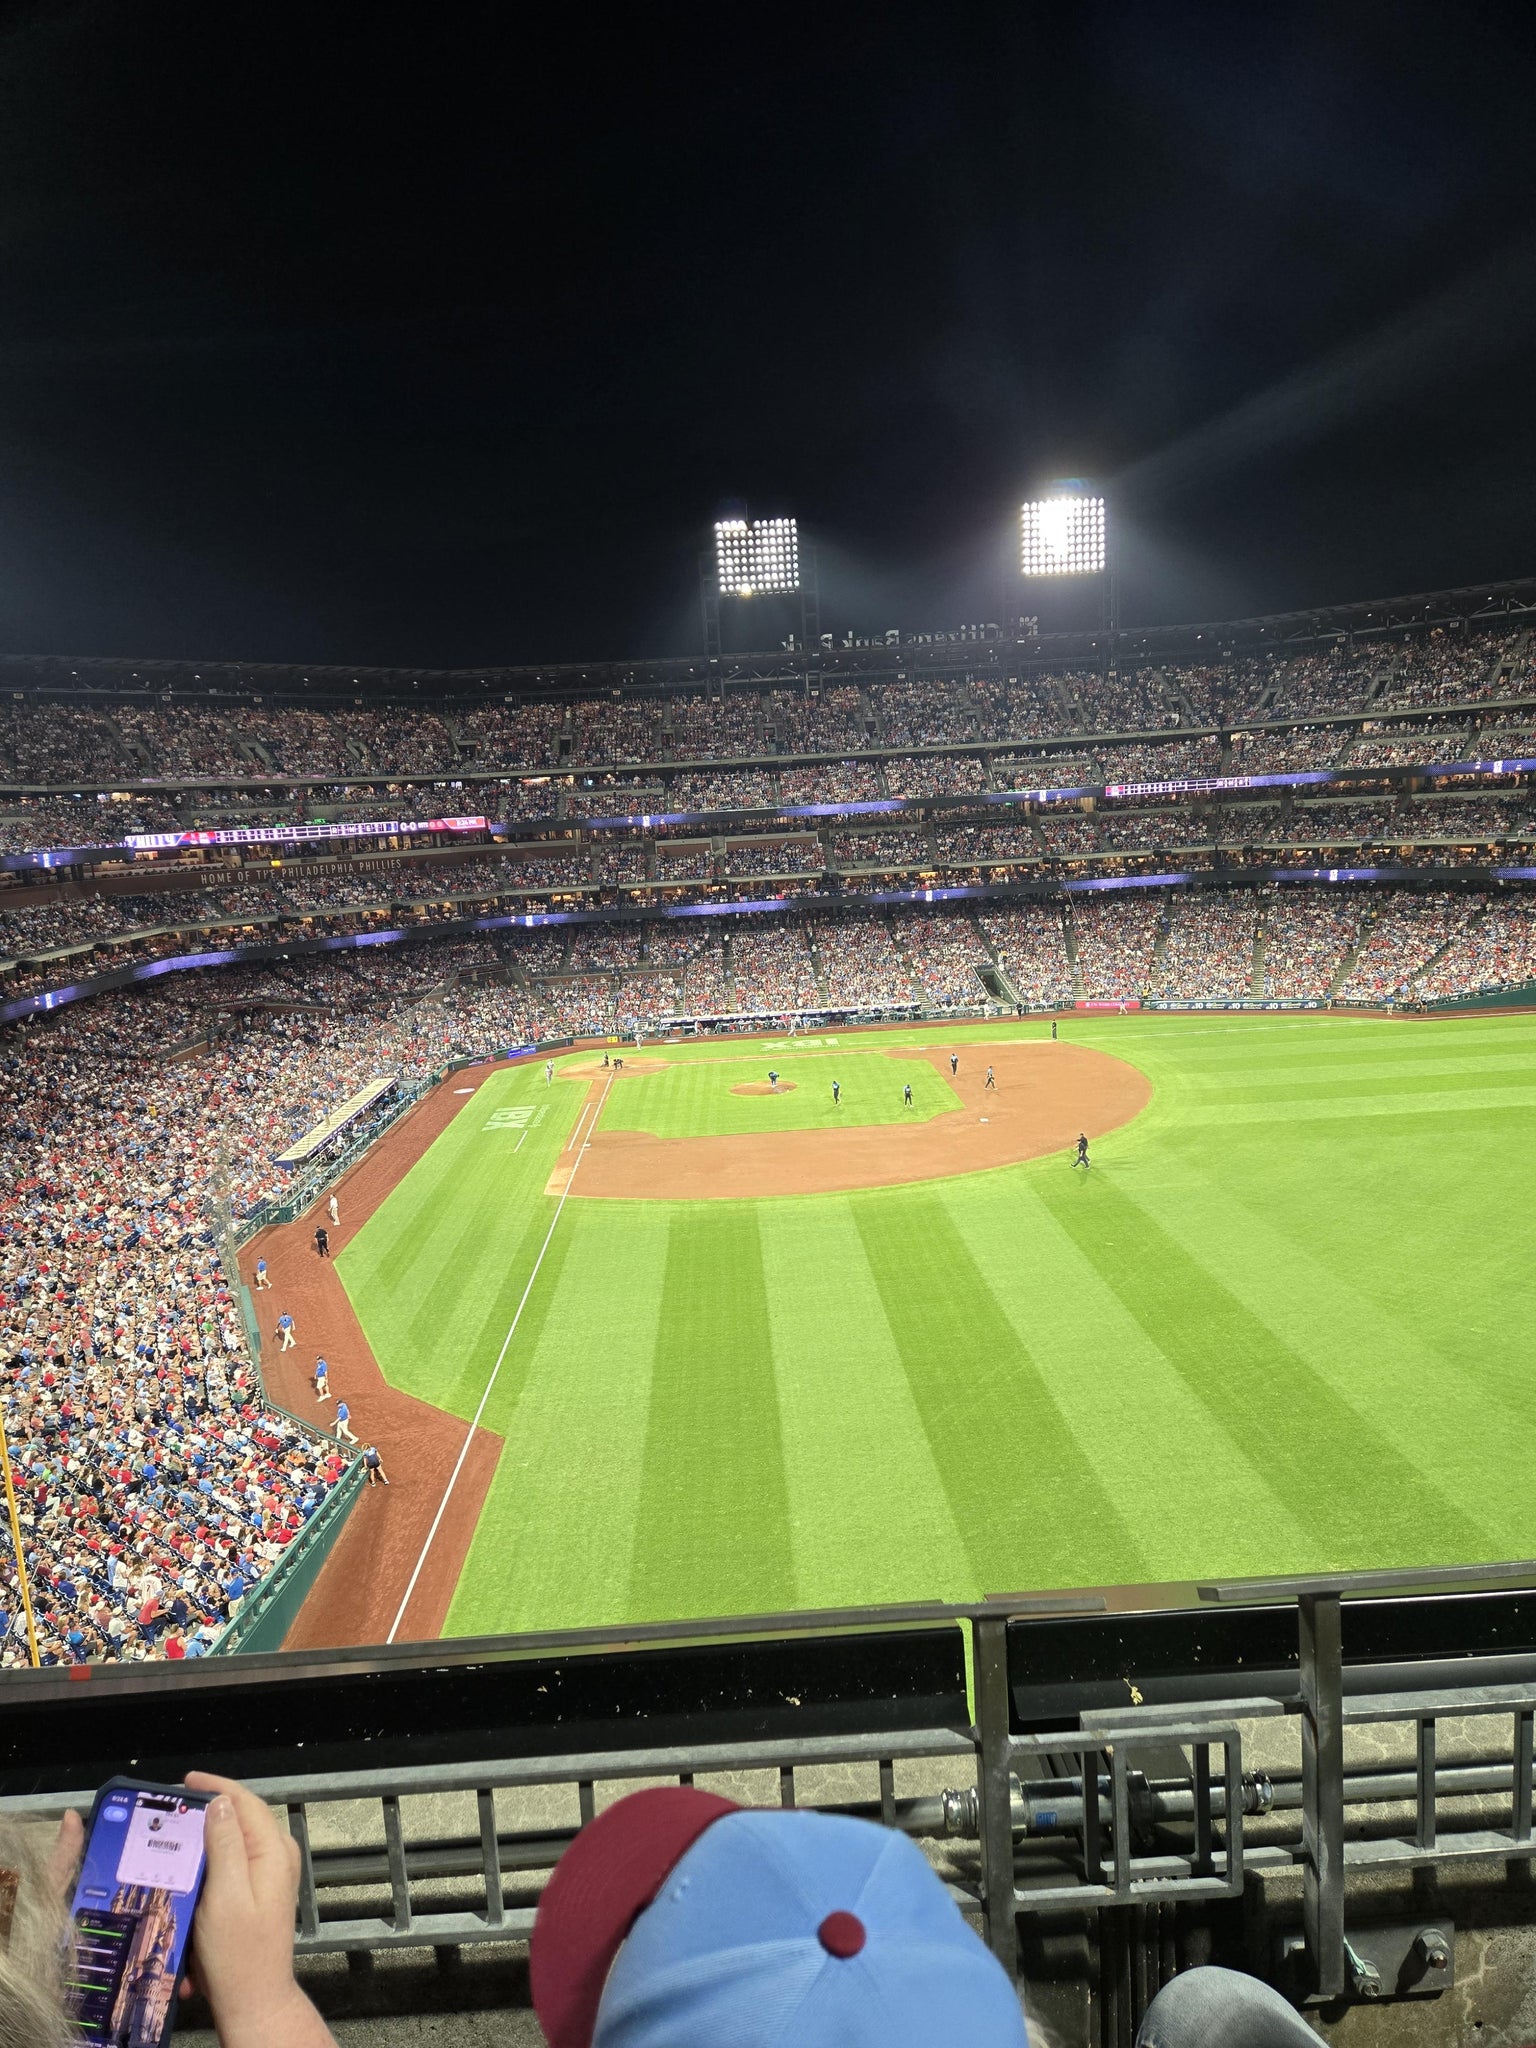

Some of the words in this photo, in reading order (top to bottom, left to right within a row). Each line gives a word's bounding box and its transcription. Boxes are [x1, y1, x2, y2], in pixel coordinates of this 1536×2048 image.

[200, 872, 232, 884] HOME
[237, 871, 251, 882] OF
[256, 868, 276, 880] THE
[281, 862, 354, 878] PHILADELPHIA
[359, 859, 402, 872] PHILLIES
[481, 1105, 537, 1132] IBX
